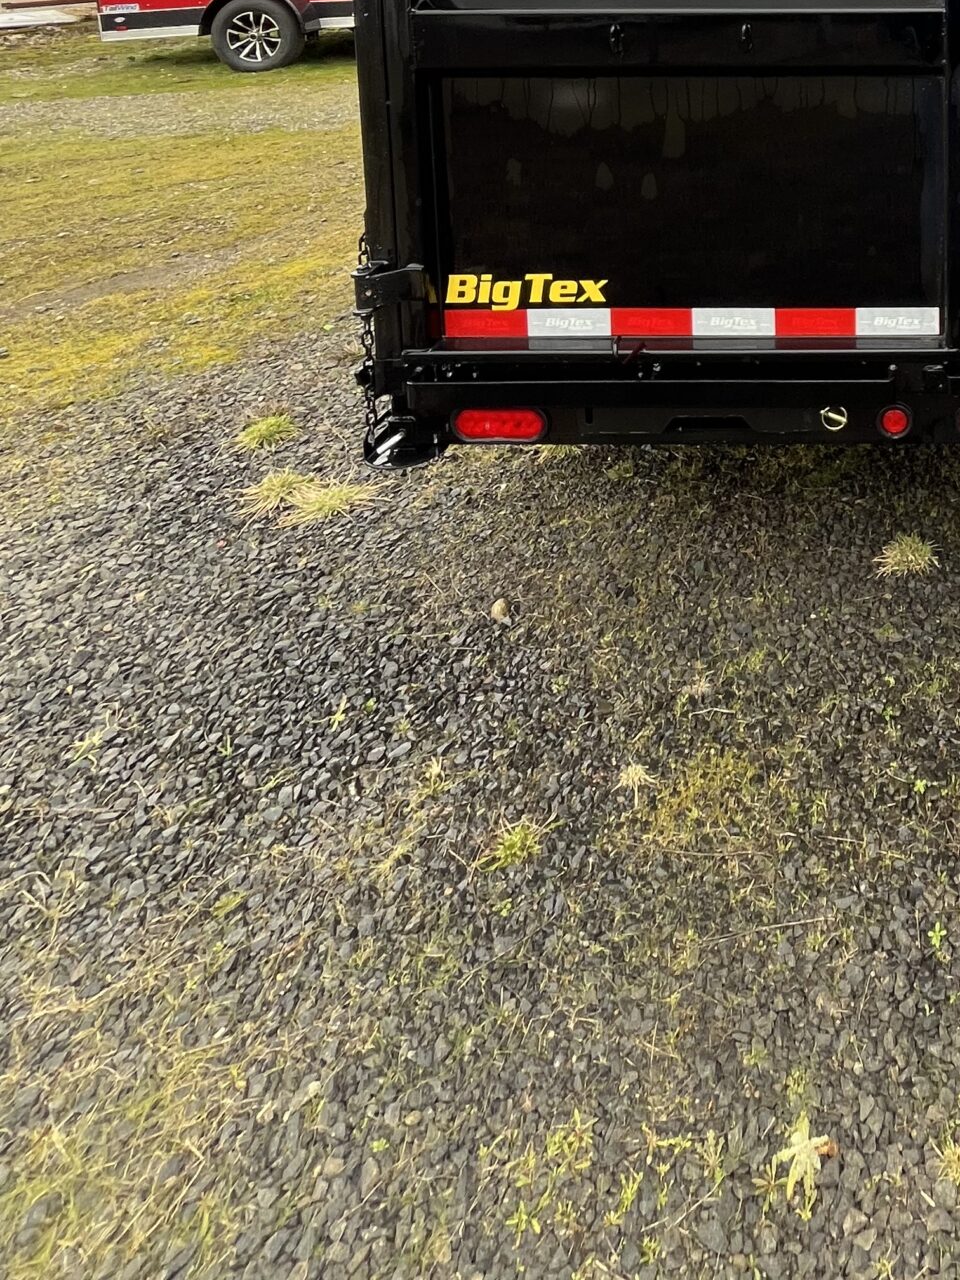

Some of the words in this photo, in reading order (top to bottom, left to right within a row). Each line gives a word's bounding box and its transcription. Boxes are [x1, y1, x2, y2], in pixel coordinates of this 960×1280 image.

[445, 273, 608, 311] BigTex
[545, 317, 593, 329] BigTex
[710, 317, 757, 328] BigTex
[874, 316, 921, 328] BigTex
